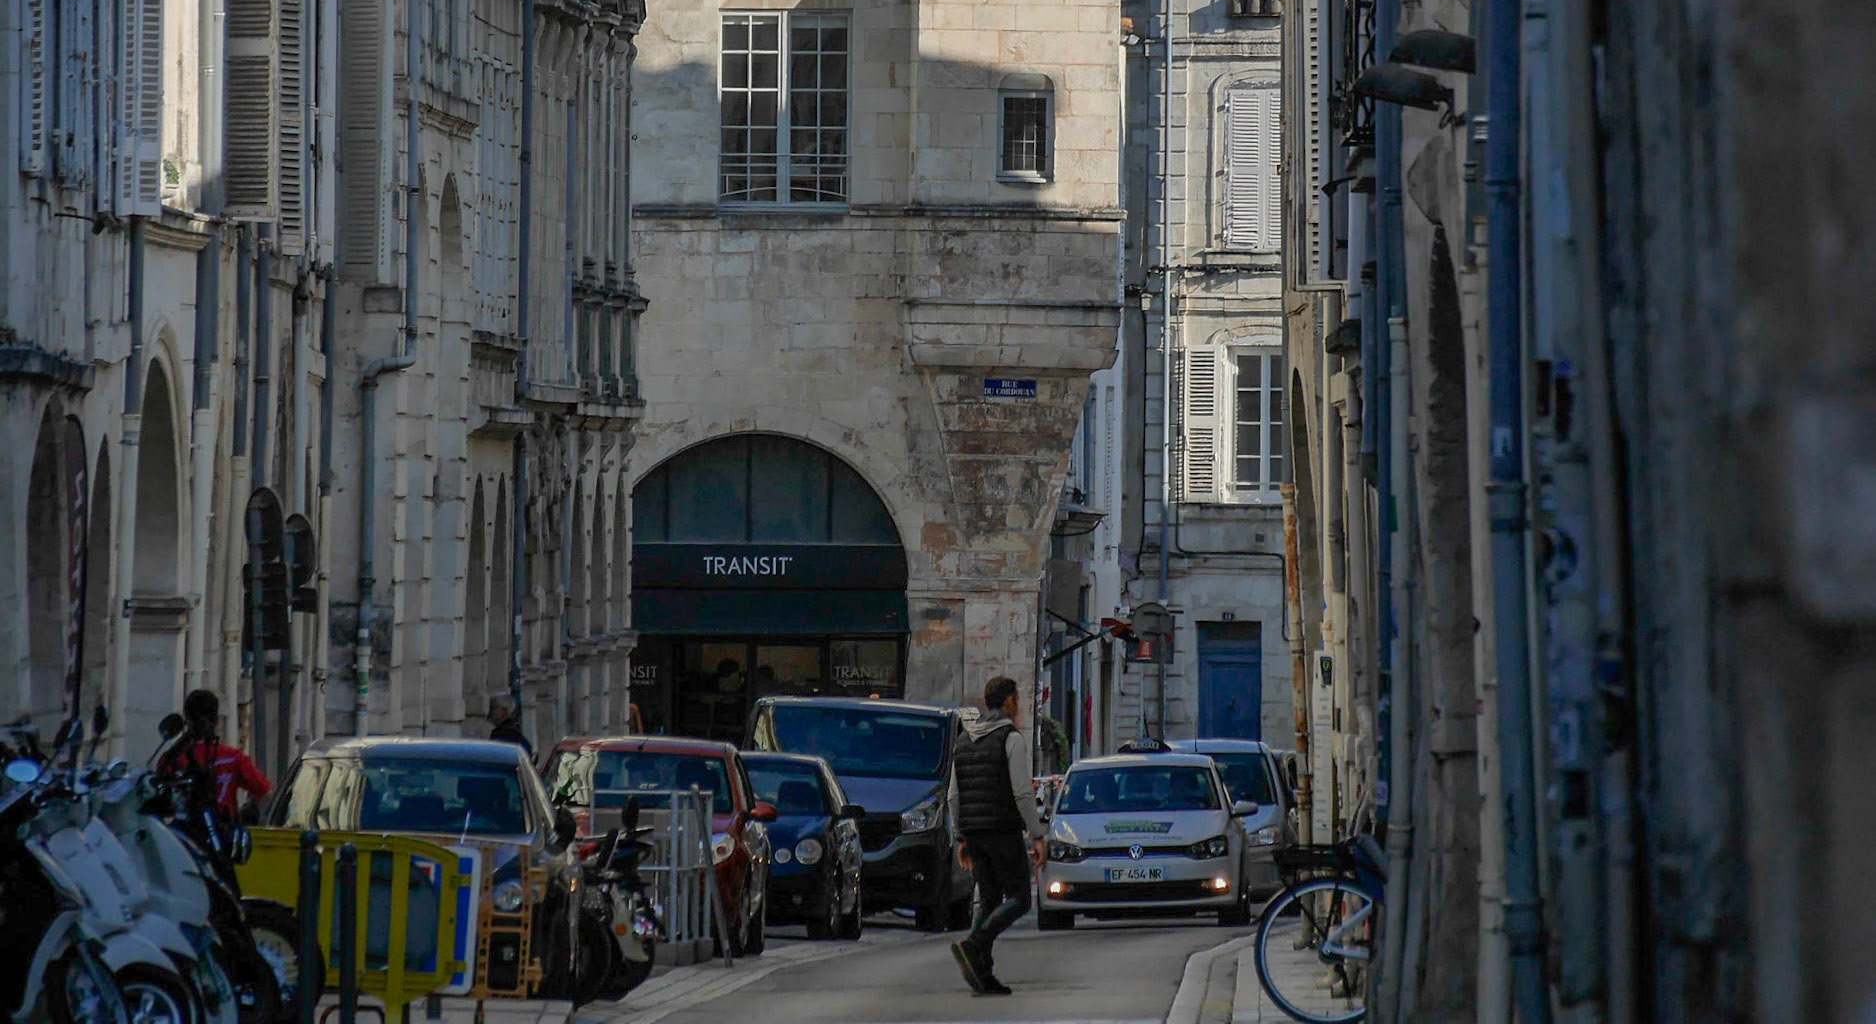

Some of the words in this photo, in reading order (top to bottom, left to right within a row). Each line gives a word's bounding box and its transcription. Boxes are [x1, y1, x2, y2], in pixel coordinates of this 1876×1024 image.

[1001, 380, 1018, 388] RUE
[996, 388, 1035, 396] CORDOUAN
[703, 556, 793, 575] TRANSIT
[833, 666, 895, 678] TRANSIT
